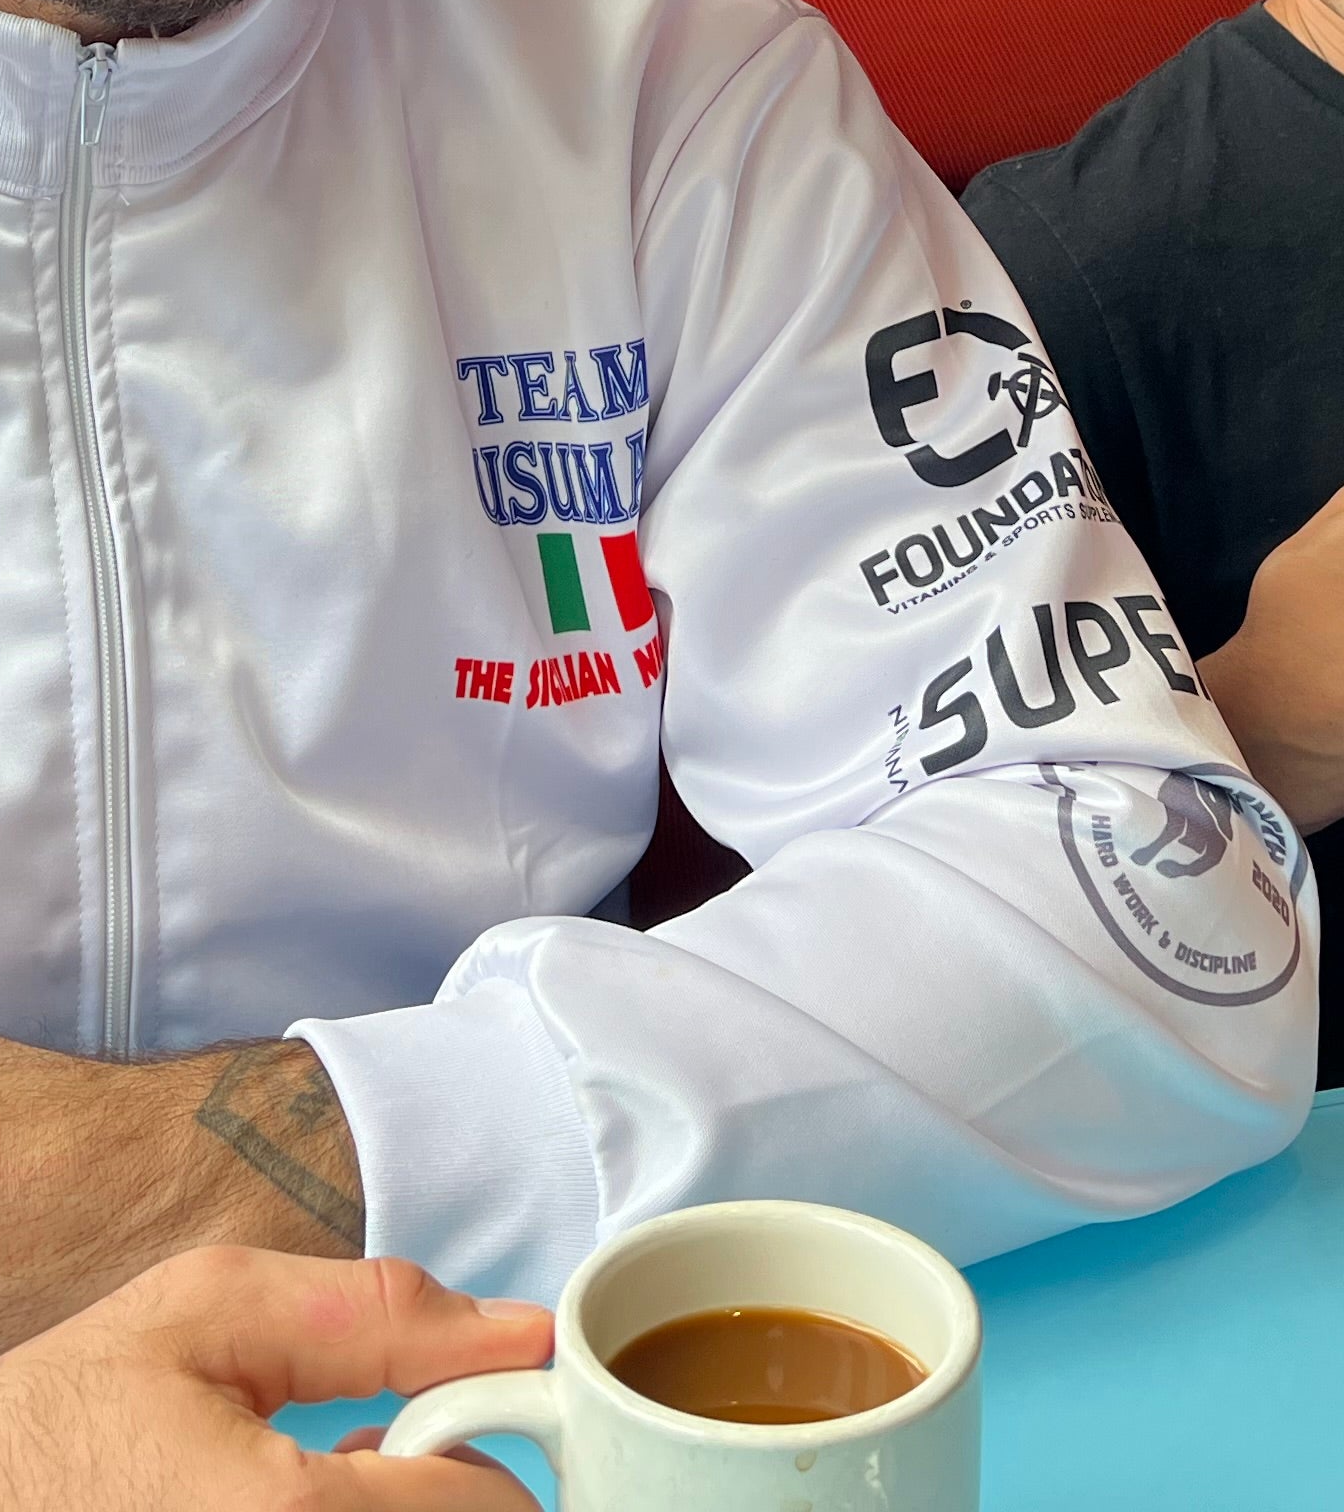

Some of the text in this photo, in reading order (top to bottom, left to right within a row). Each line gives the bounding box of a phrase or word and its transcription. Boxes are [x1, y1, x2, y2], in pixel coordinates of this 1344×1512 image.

[456, 337, 650, 426] TEAM
[887, 565, 978, 615] VITAMINS
[984, 551, 997, 562] &
[1002, 503, 1075, 547] SPORTS
[454, 657, 515, 705] THE
[1091, 815, 1119, 867] HARD
[1113, 872, 1159, 936] WORK
[1174, 942, 1257, 975] DISCIPLINE
[1252, 859, 1290, 927] 2020
